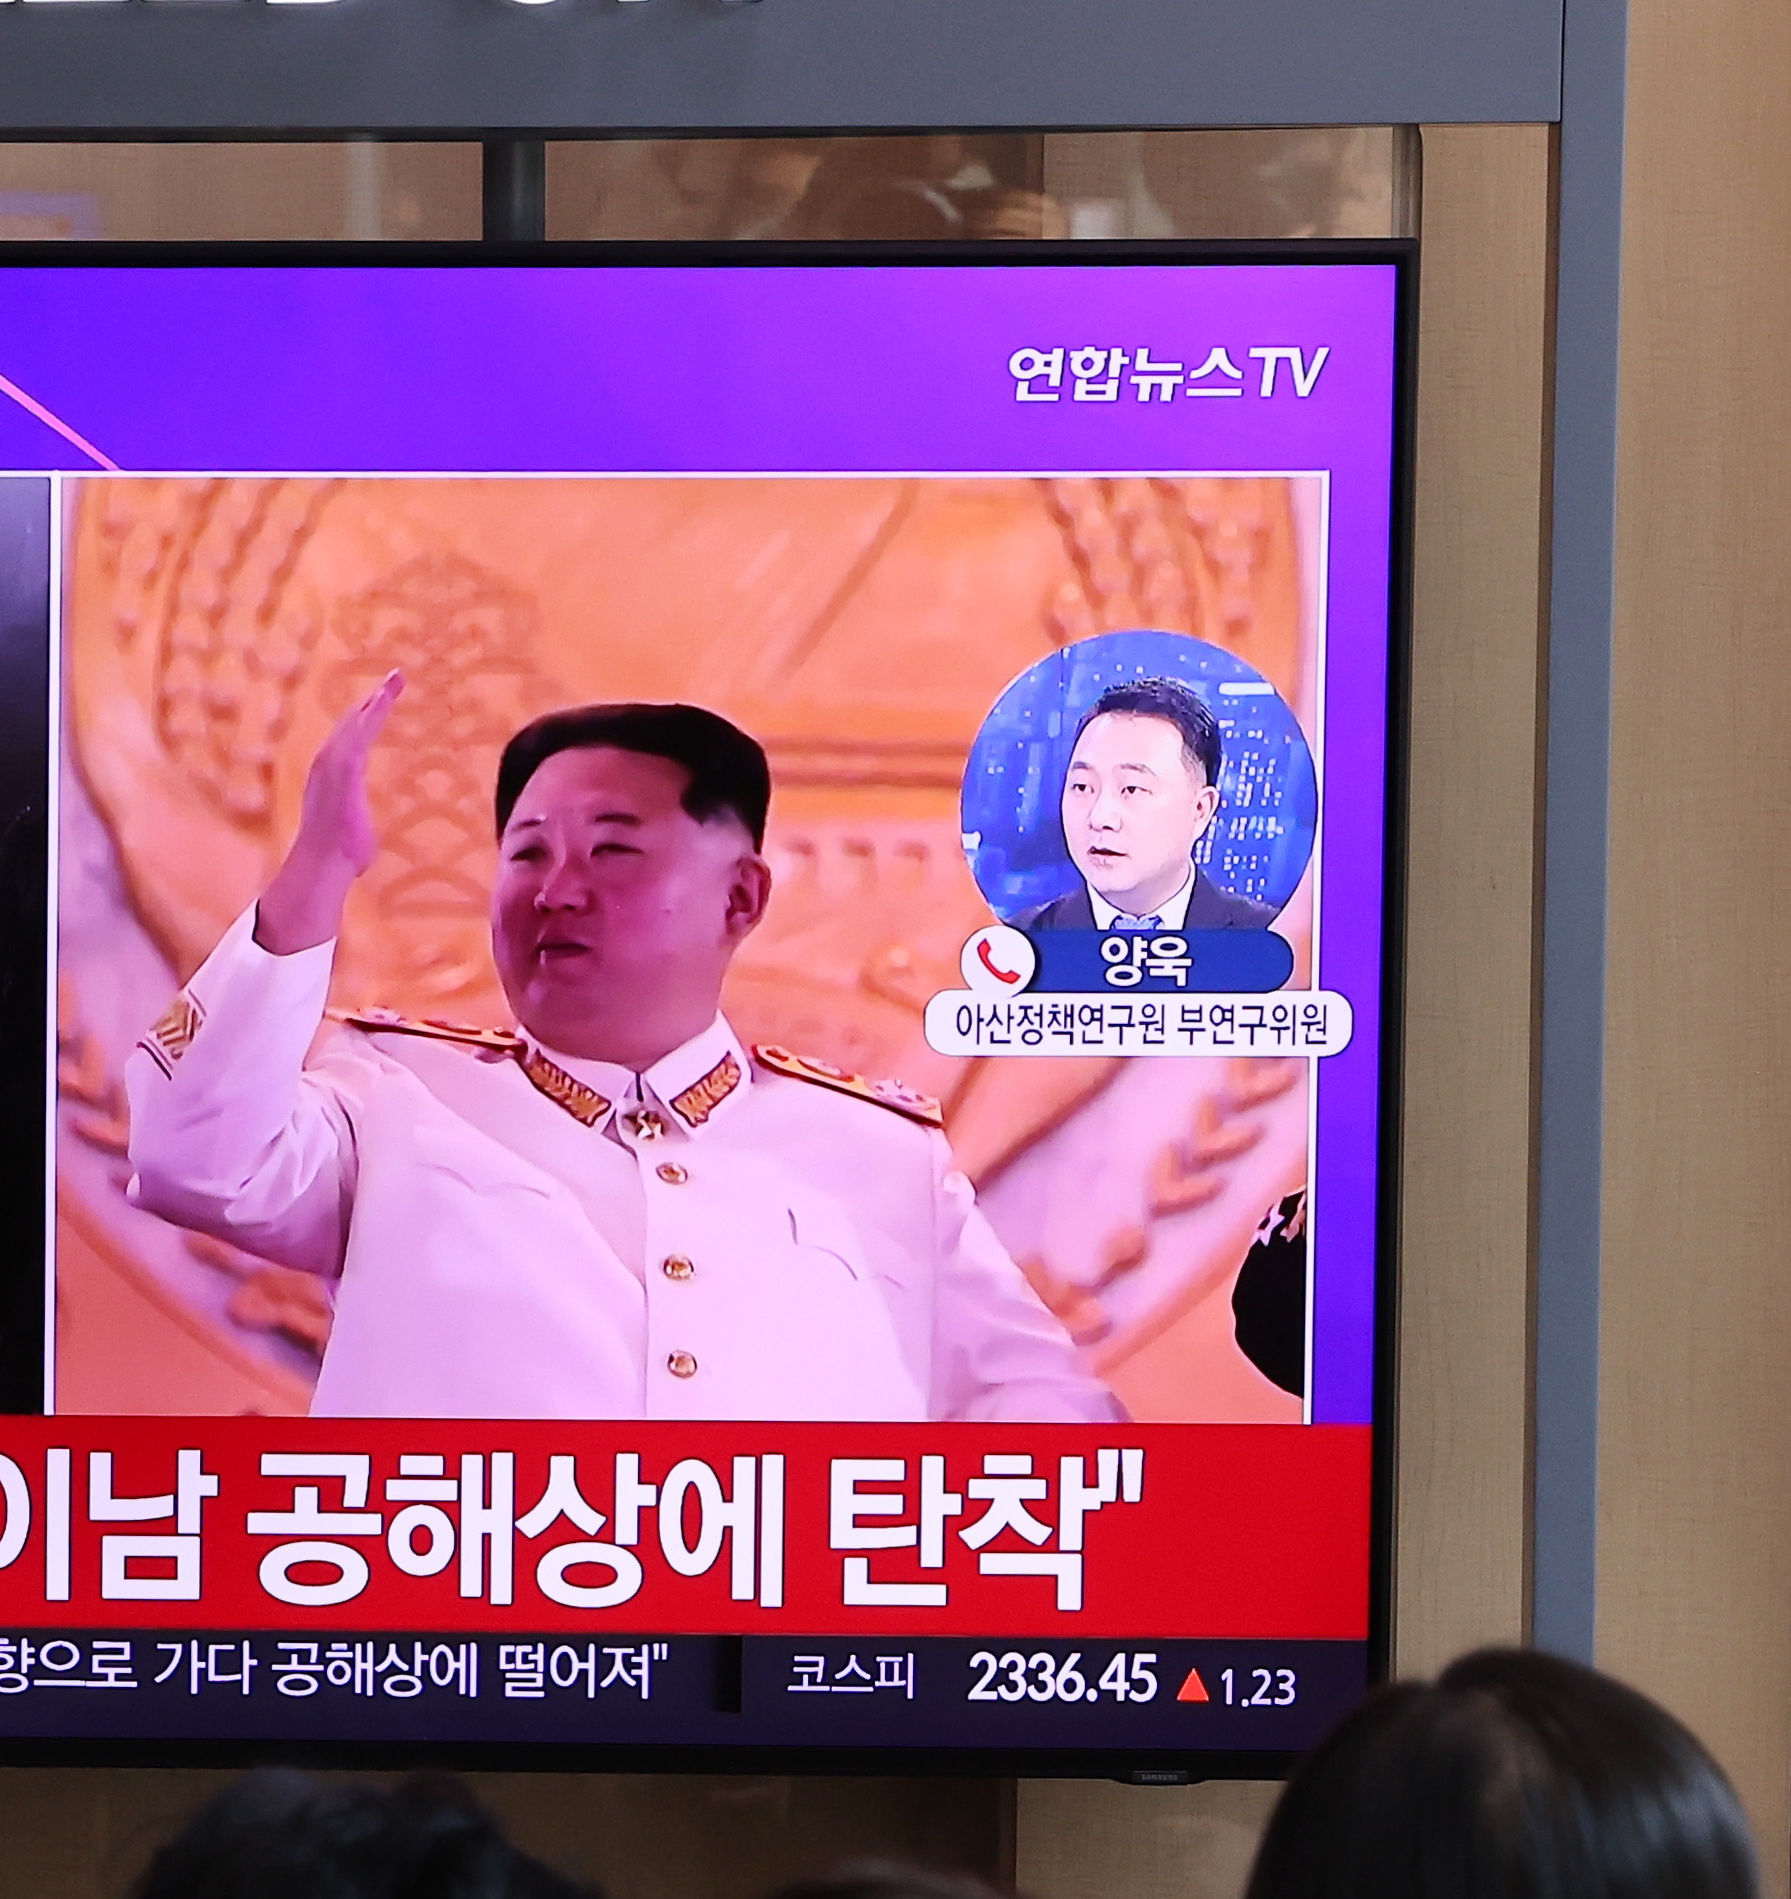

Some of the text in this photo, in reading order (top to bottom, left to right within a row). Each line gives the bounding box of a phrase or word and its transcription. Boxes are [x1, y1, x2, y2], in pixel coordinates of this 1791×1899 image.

[1008, 345, 1330, 402] 연합뉴스TV
[1100, 935, 1192, 987] 양욱
[955, 1002, 1327, 1046] 아산정책연구원 부연구위원
[246, 1451, 784, 1608] 공해상에
[829, 1447, 1144, 1611] 탄착"
[153, 1638, 258, 1695] 가다
[270, 1640, 477, 1698] 공해상에
[498, 1641, 668, 1700] 떨어져"
[786, 1650, 1296, 1707] 코스피 2336.45 1.23
